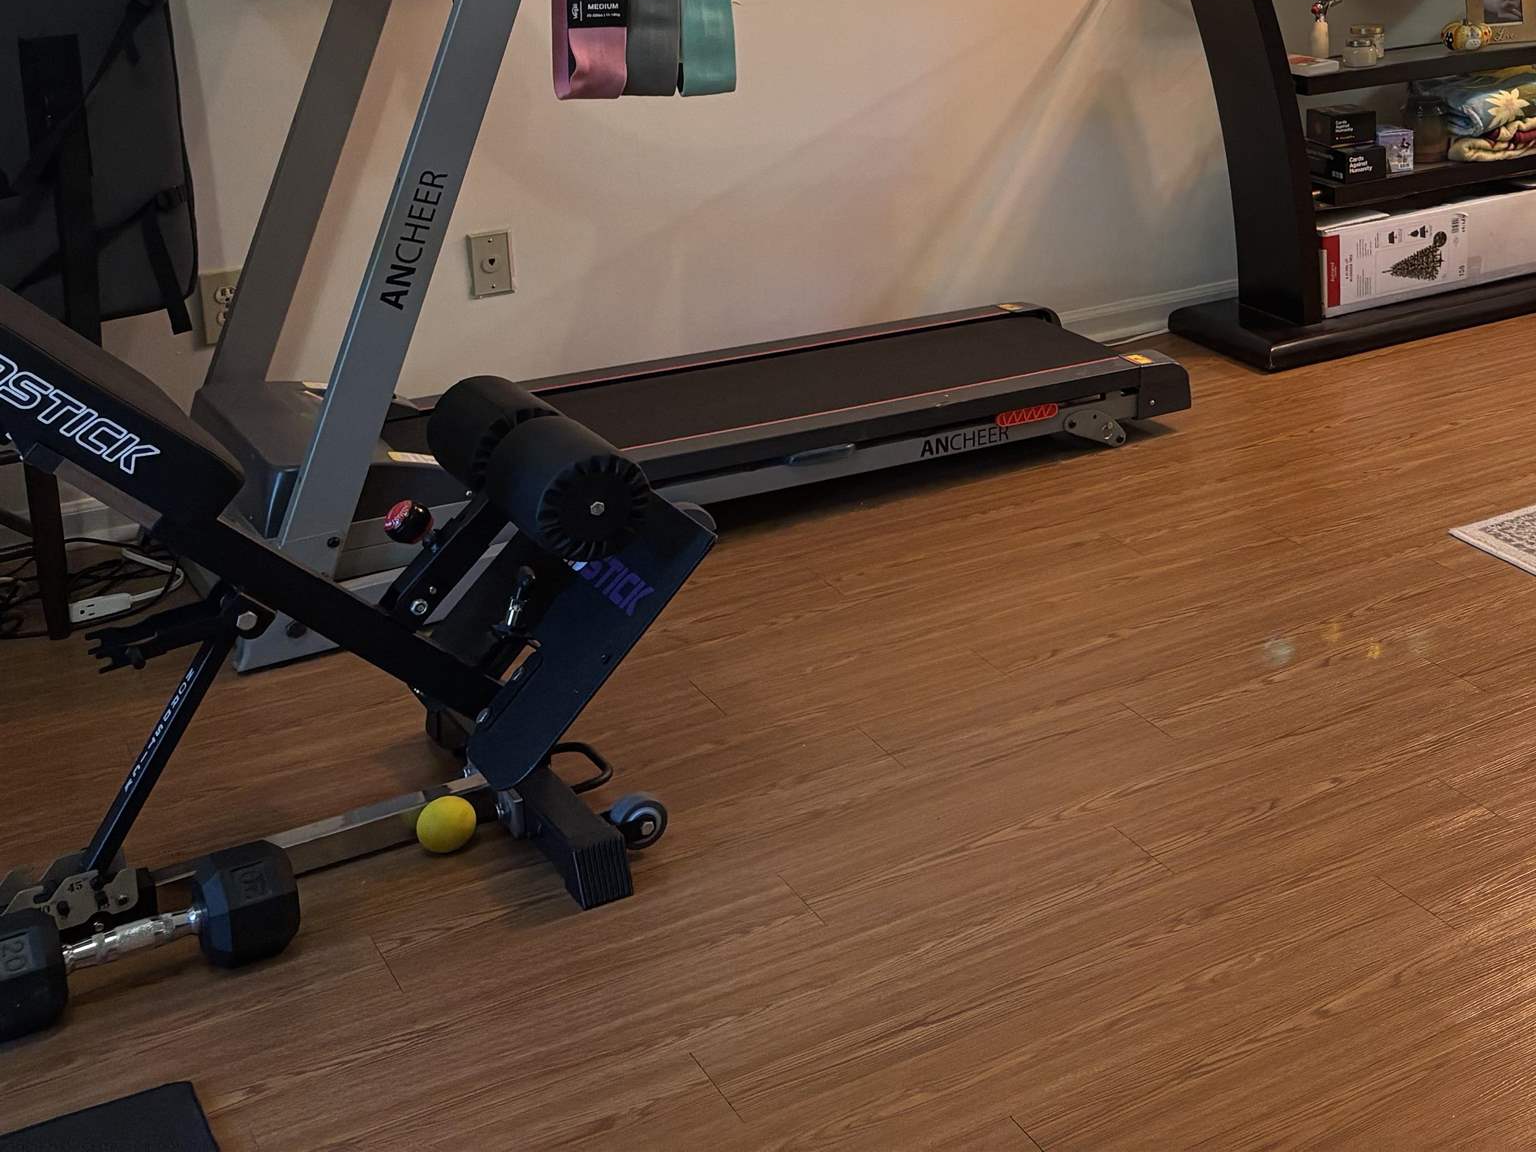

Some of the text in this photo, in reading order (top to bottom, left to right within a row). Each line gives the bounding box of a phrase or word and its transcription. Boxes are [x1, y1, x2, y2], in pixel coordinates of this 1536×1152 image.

[587, 2, 619, 10] MEDIUM
[1349, 165, 1373, 174] Humanity
[380, 170, 448, 310] ANCHEER
[920, 425, 1009, 458] ANCHEER
[66, 880, 83, 893] 45
